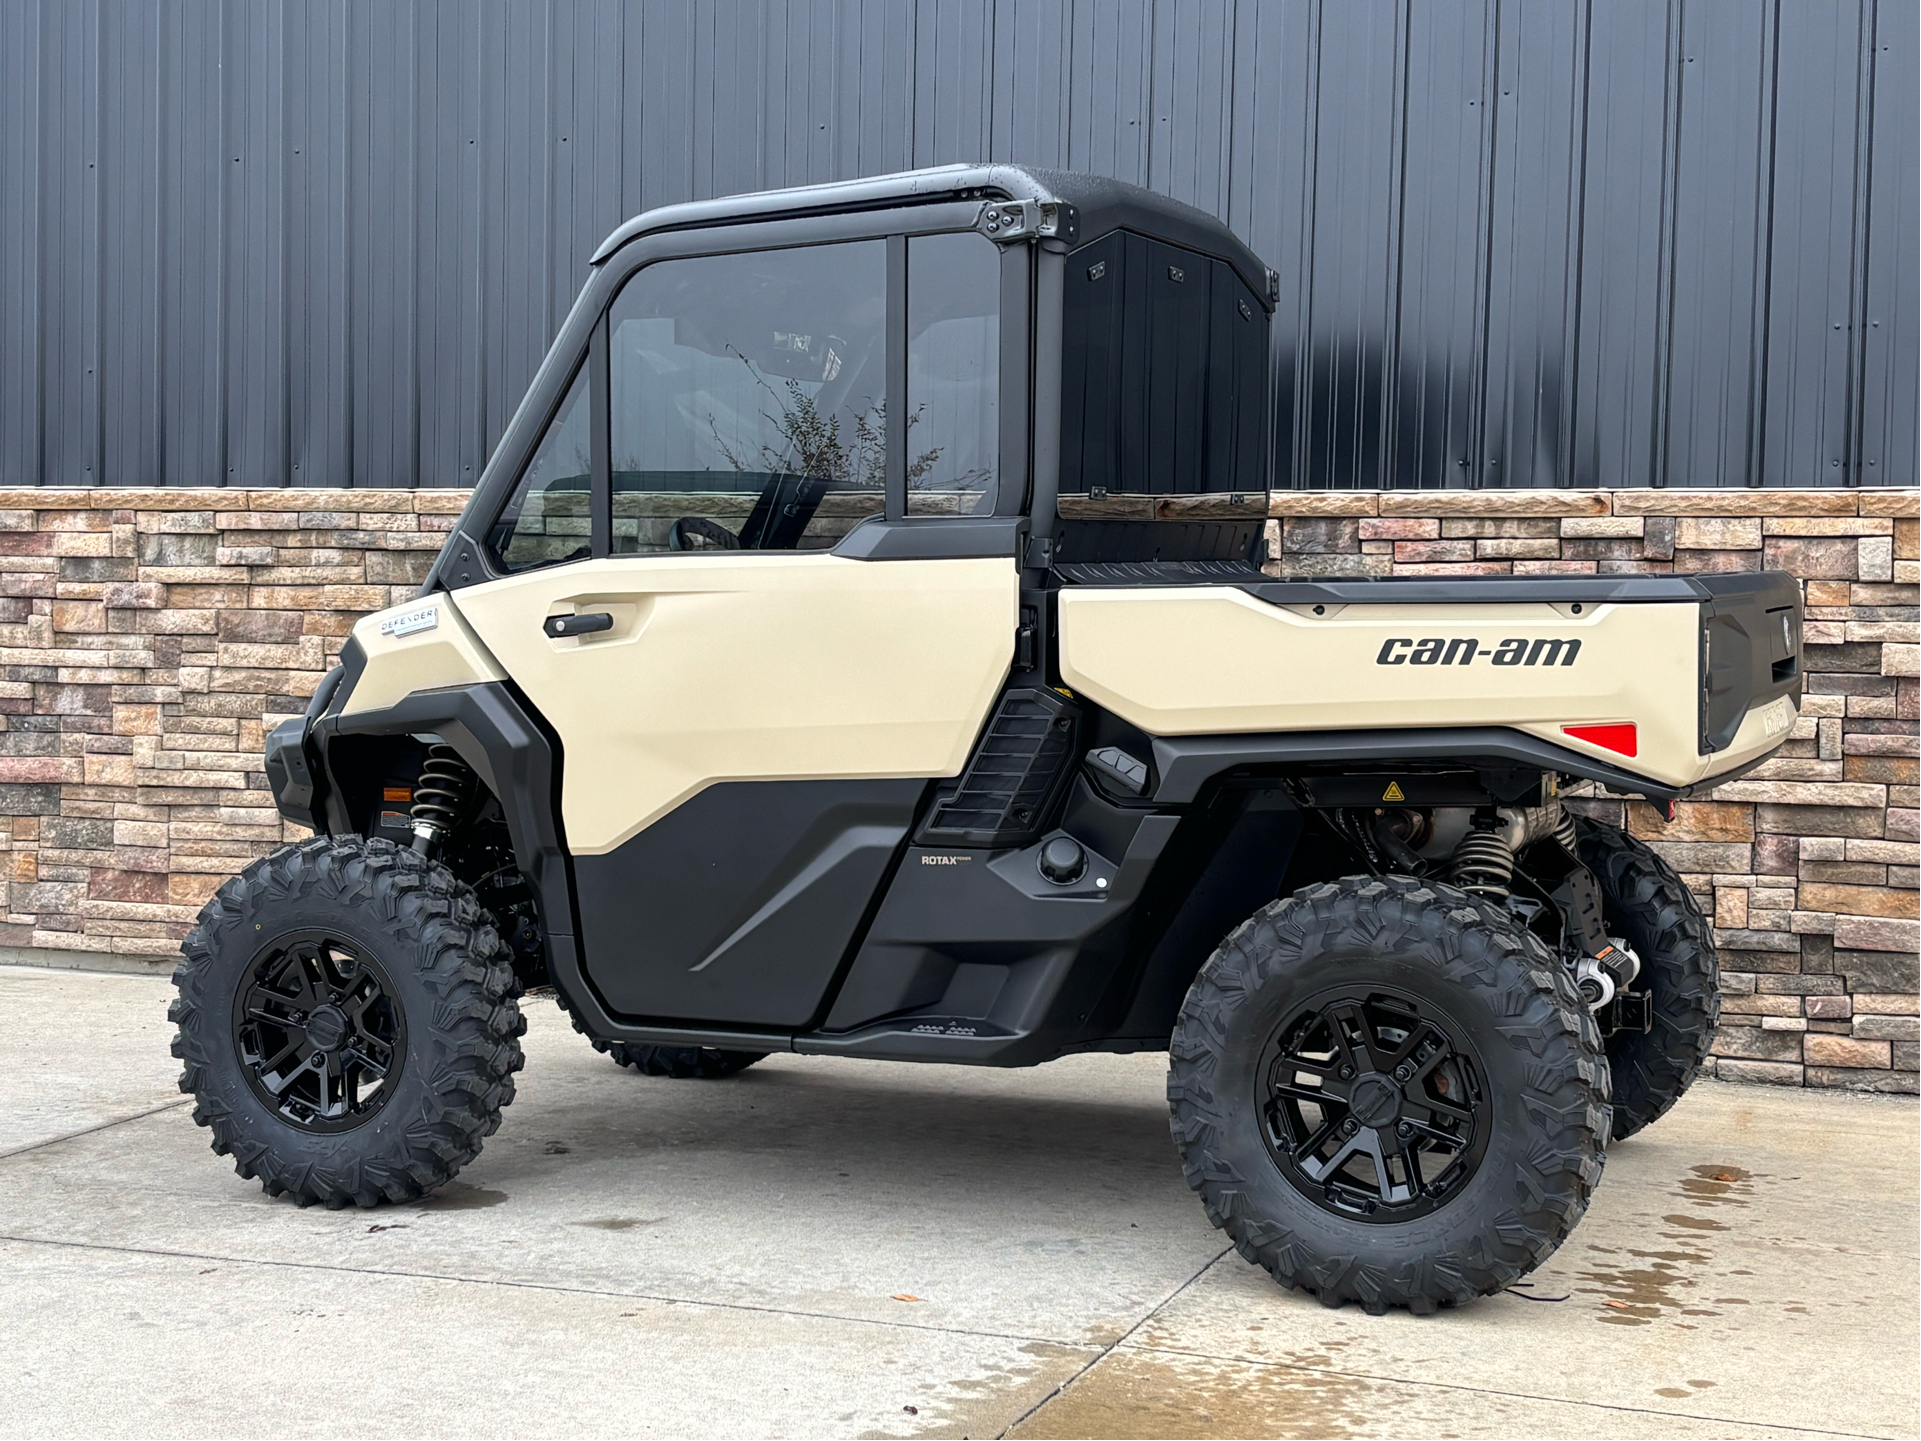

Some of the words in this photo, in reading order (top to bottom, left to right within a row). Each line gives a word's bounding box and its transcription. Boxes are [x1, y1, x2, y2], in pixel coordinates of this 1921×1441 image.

[381, 609, 433, 630] DEFENDER
[1376, 638, 1582, 666] can-am
[921, 855, 957, 865] ROTAX
